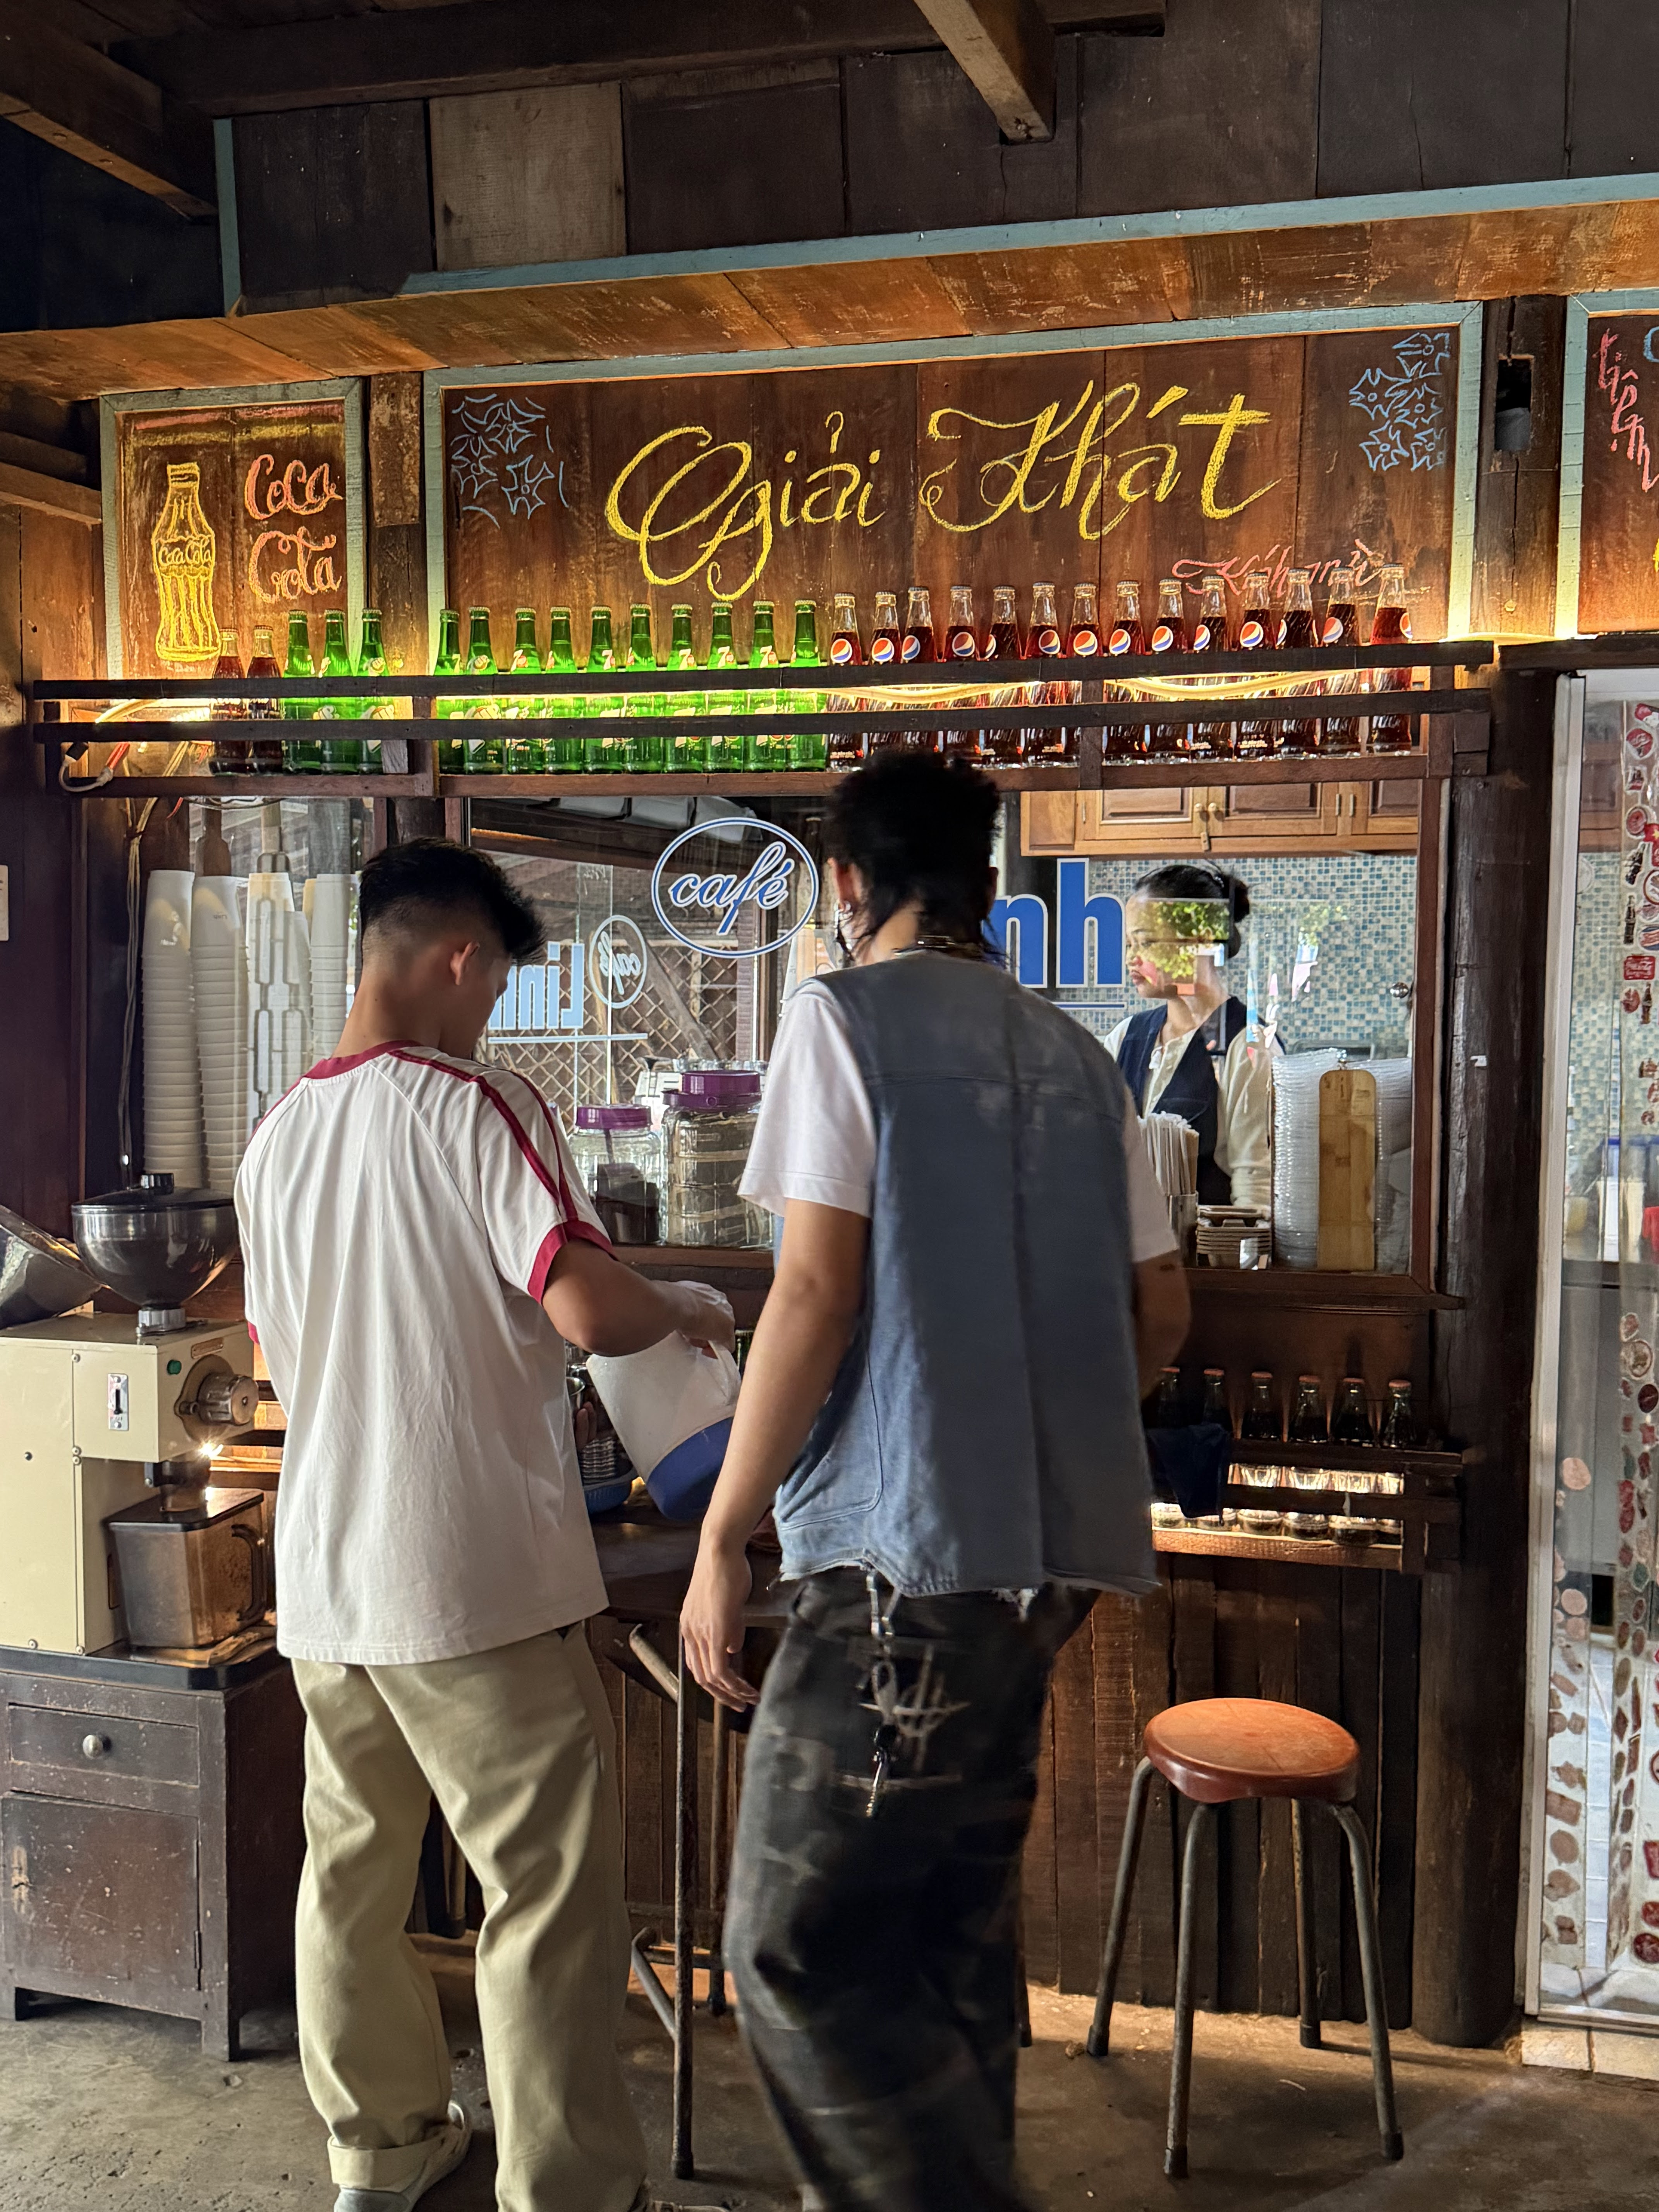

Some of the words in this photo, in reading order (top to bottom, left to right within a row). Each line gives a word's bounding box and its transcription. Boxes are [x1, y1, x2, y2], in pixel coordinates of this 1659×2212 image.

[244, 454, 343, 520] Coca
[605, 410, 885, 601] Giải
[920, 380, 1281, 541] Khát
[248, 526, 343, 603] Cola
[668, 841, 795, 936] café
[981, 858, 1126, 988] nh
